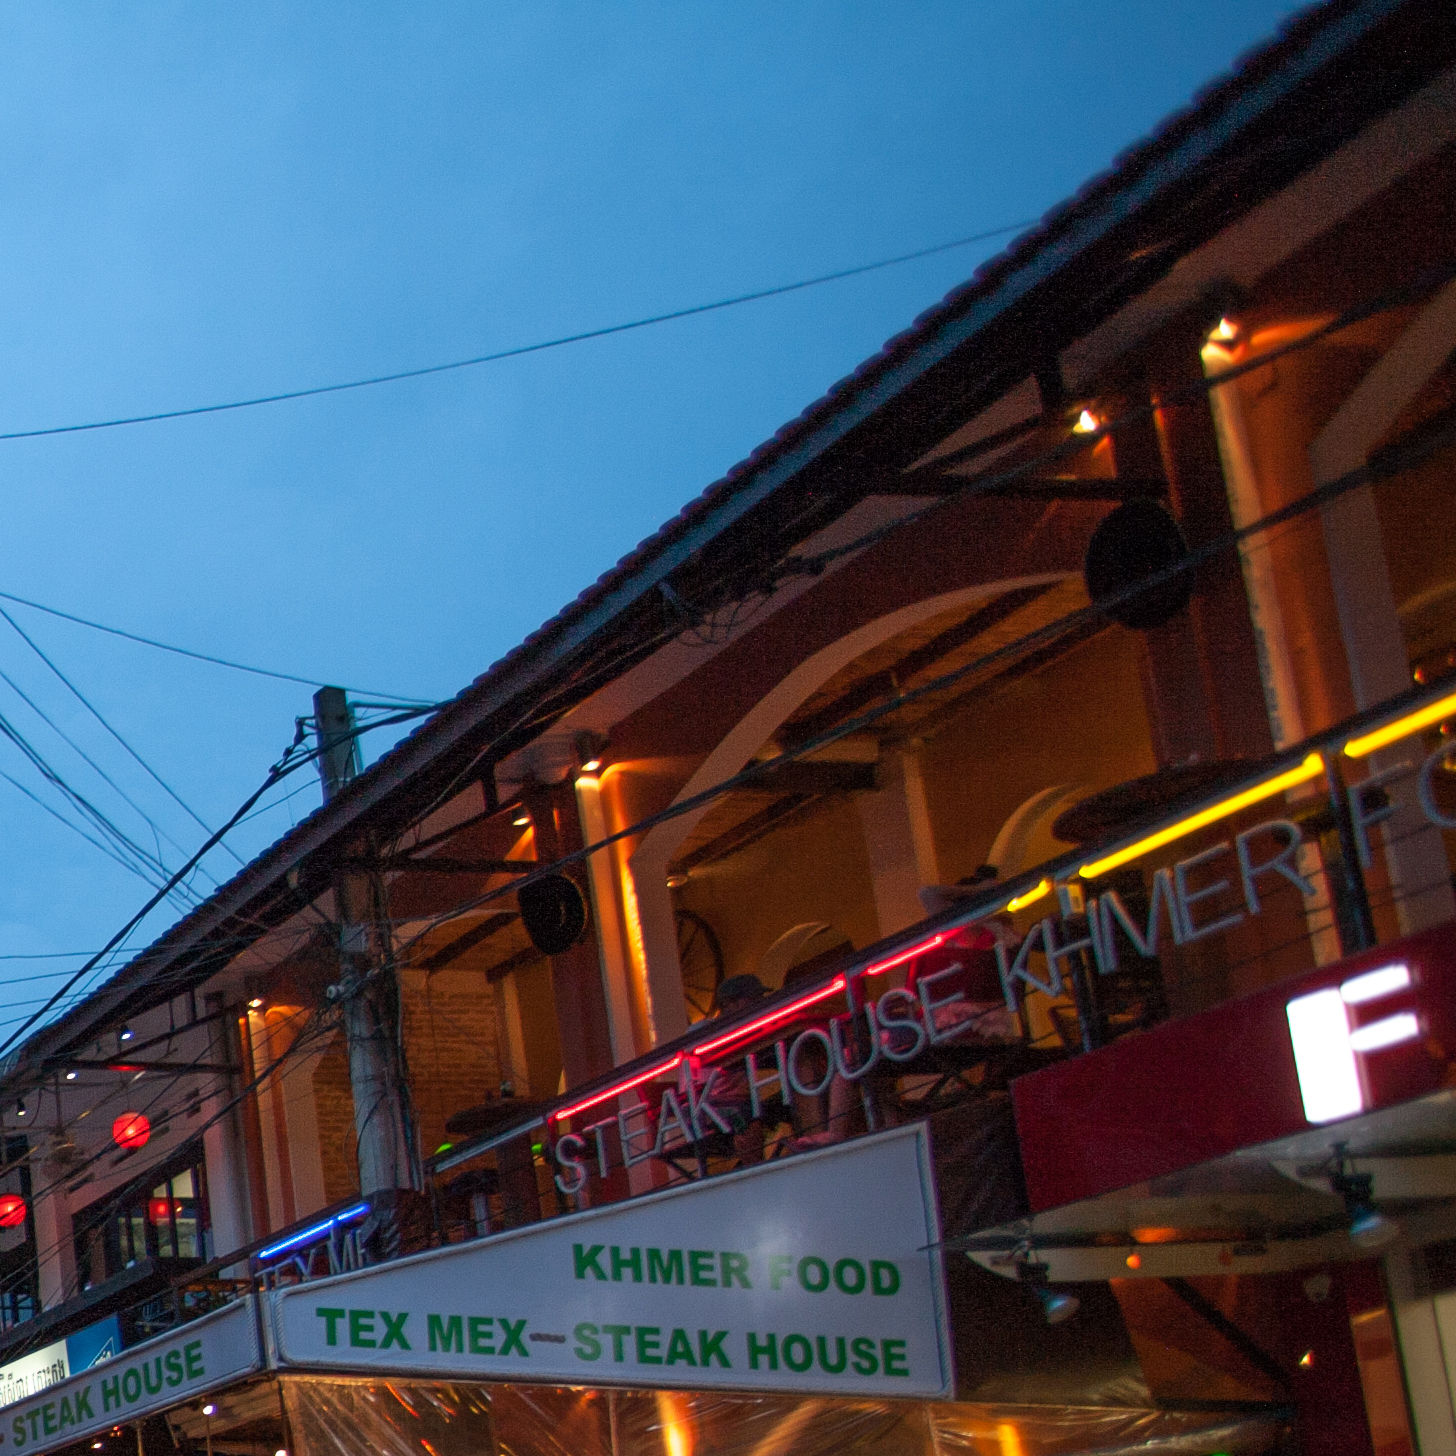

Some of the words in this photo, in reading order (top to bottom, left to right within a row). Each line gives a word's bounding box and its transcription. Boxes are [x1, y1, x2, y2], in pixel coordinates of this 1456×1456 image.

[552, 1064, 733, 1196] STEAK
[746, 962, 974, 1118] HOUSE
[994, 818, 1320, 1014] KHMER
[1285, 962, 1421, 1126] F
[573, 1242, 752, 1289] KHMER
[768, 1254, 901, 1297] FOOD
[11, 1387, 95, 1449] STEAK
[100, 1340, 206, 1408] HOUSE
[315, 1306, 411, 1352] TEX
[573, 1322, 730, 1370] STEAK
[748, 1331, 909, 1378] HOUSE
